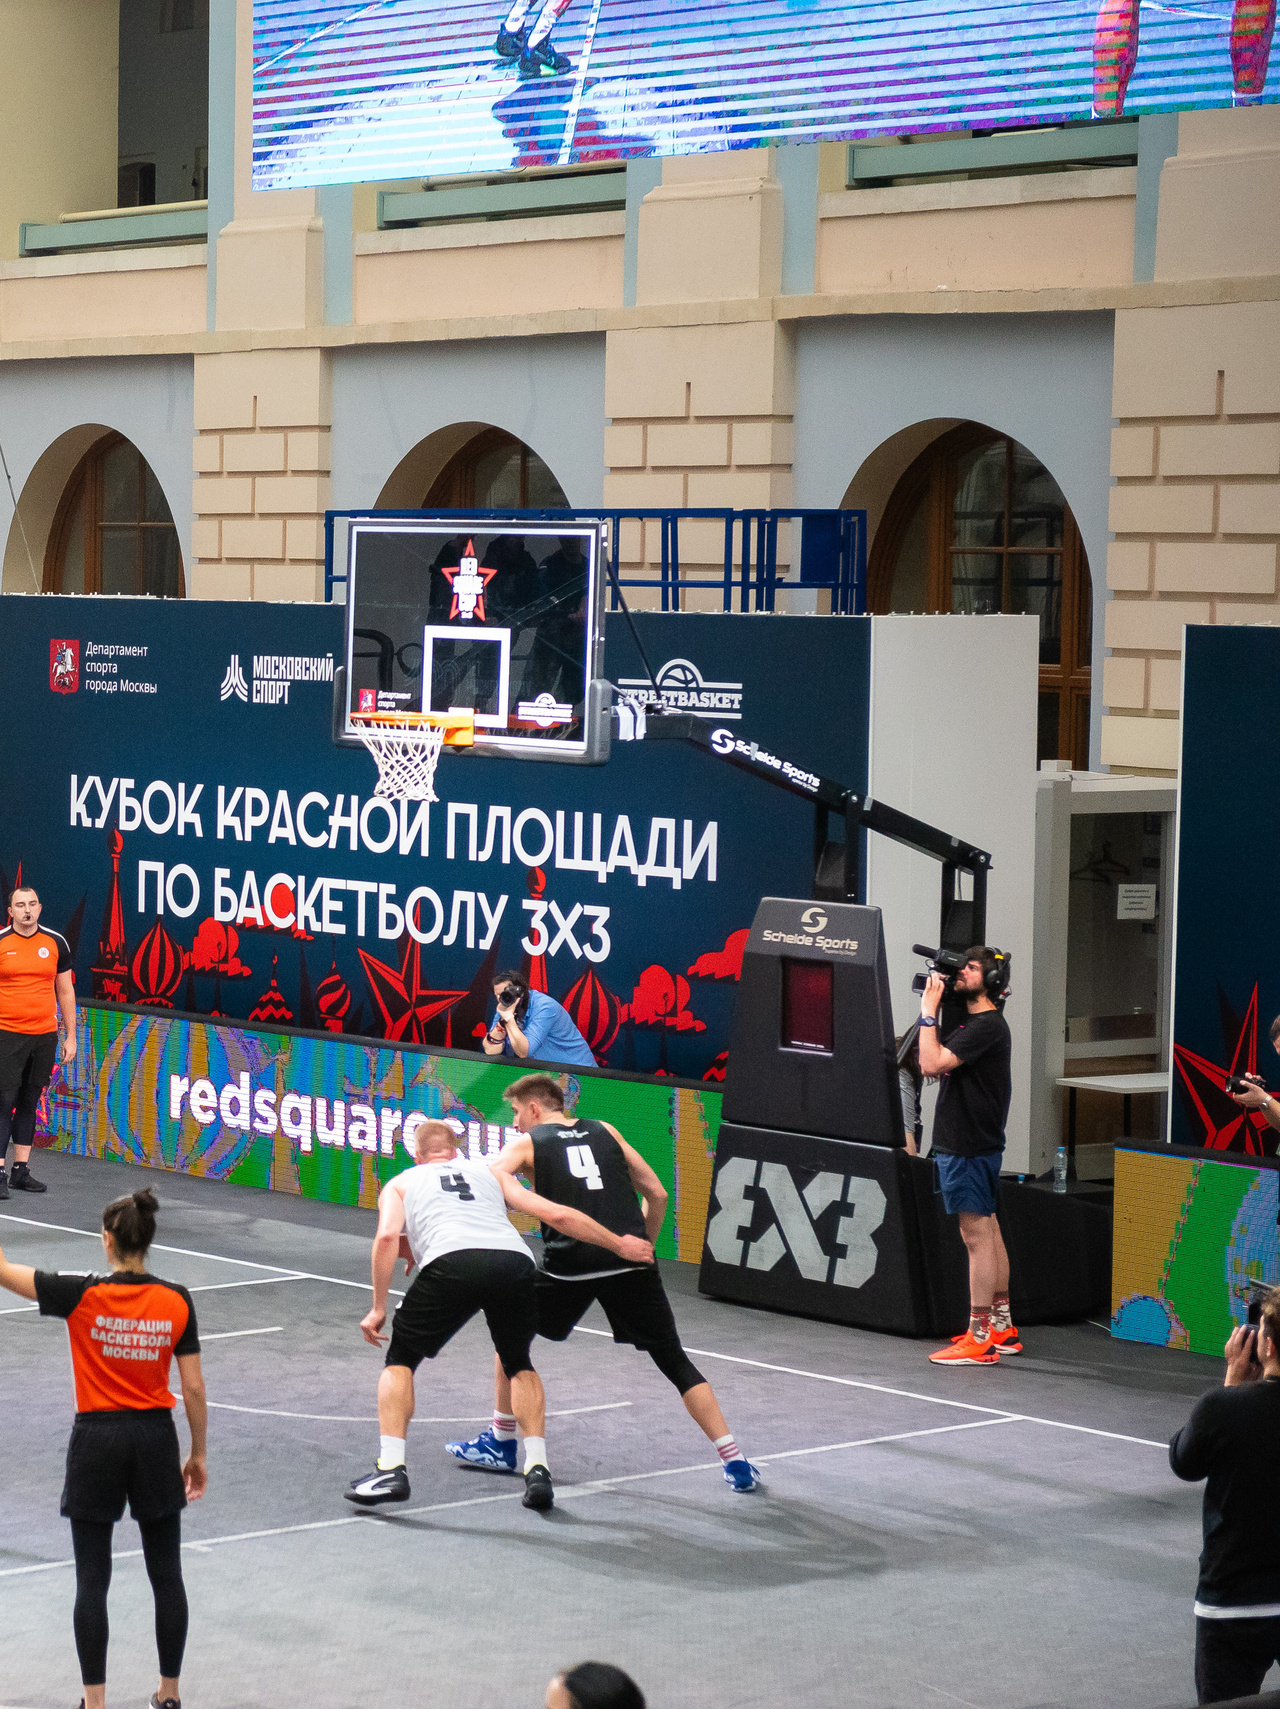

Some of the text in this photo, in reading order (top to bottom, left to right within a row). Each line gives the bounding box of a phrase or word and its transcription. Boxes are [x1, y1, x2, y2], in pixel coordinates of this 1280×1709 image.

[85, 641, 148, 657] Департамент
[85, 661, 118, 676] спорта
[252, 653, 334, 682] МОСКОВСКИЙ
[85, 679, 158, 694] города Москвы
[252, 680, 291, 704] СПОРТ
[734, 739, 782, 770] Scelde
[781, 761, 821, 787] Sports
[70, 773, 205, 838] КУБОК
[446, 801, 718, 890] ПЛОЩАДИ
[138, 860, 201, 918] ПО
[214, 867, 509, 950] БАСКЕТБОЛУ
[814, 935, 859, 951] Sports
[566, 1144, 605, 1191] 4
[439, 1171, 476, 1201] 4
[95, 1314, 173, 1334] ФЕДЕРАЦИЯ
[90, 1327, 172, 1347] БАСКЕТБОЛА
[102, 1344, 160, 1362] МОСКВЫ
